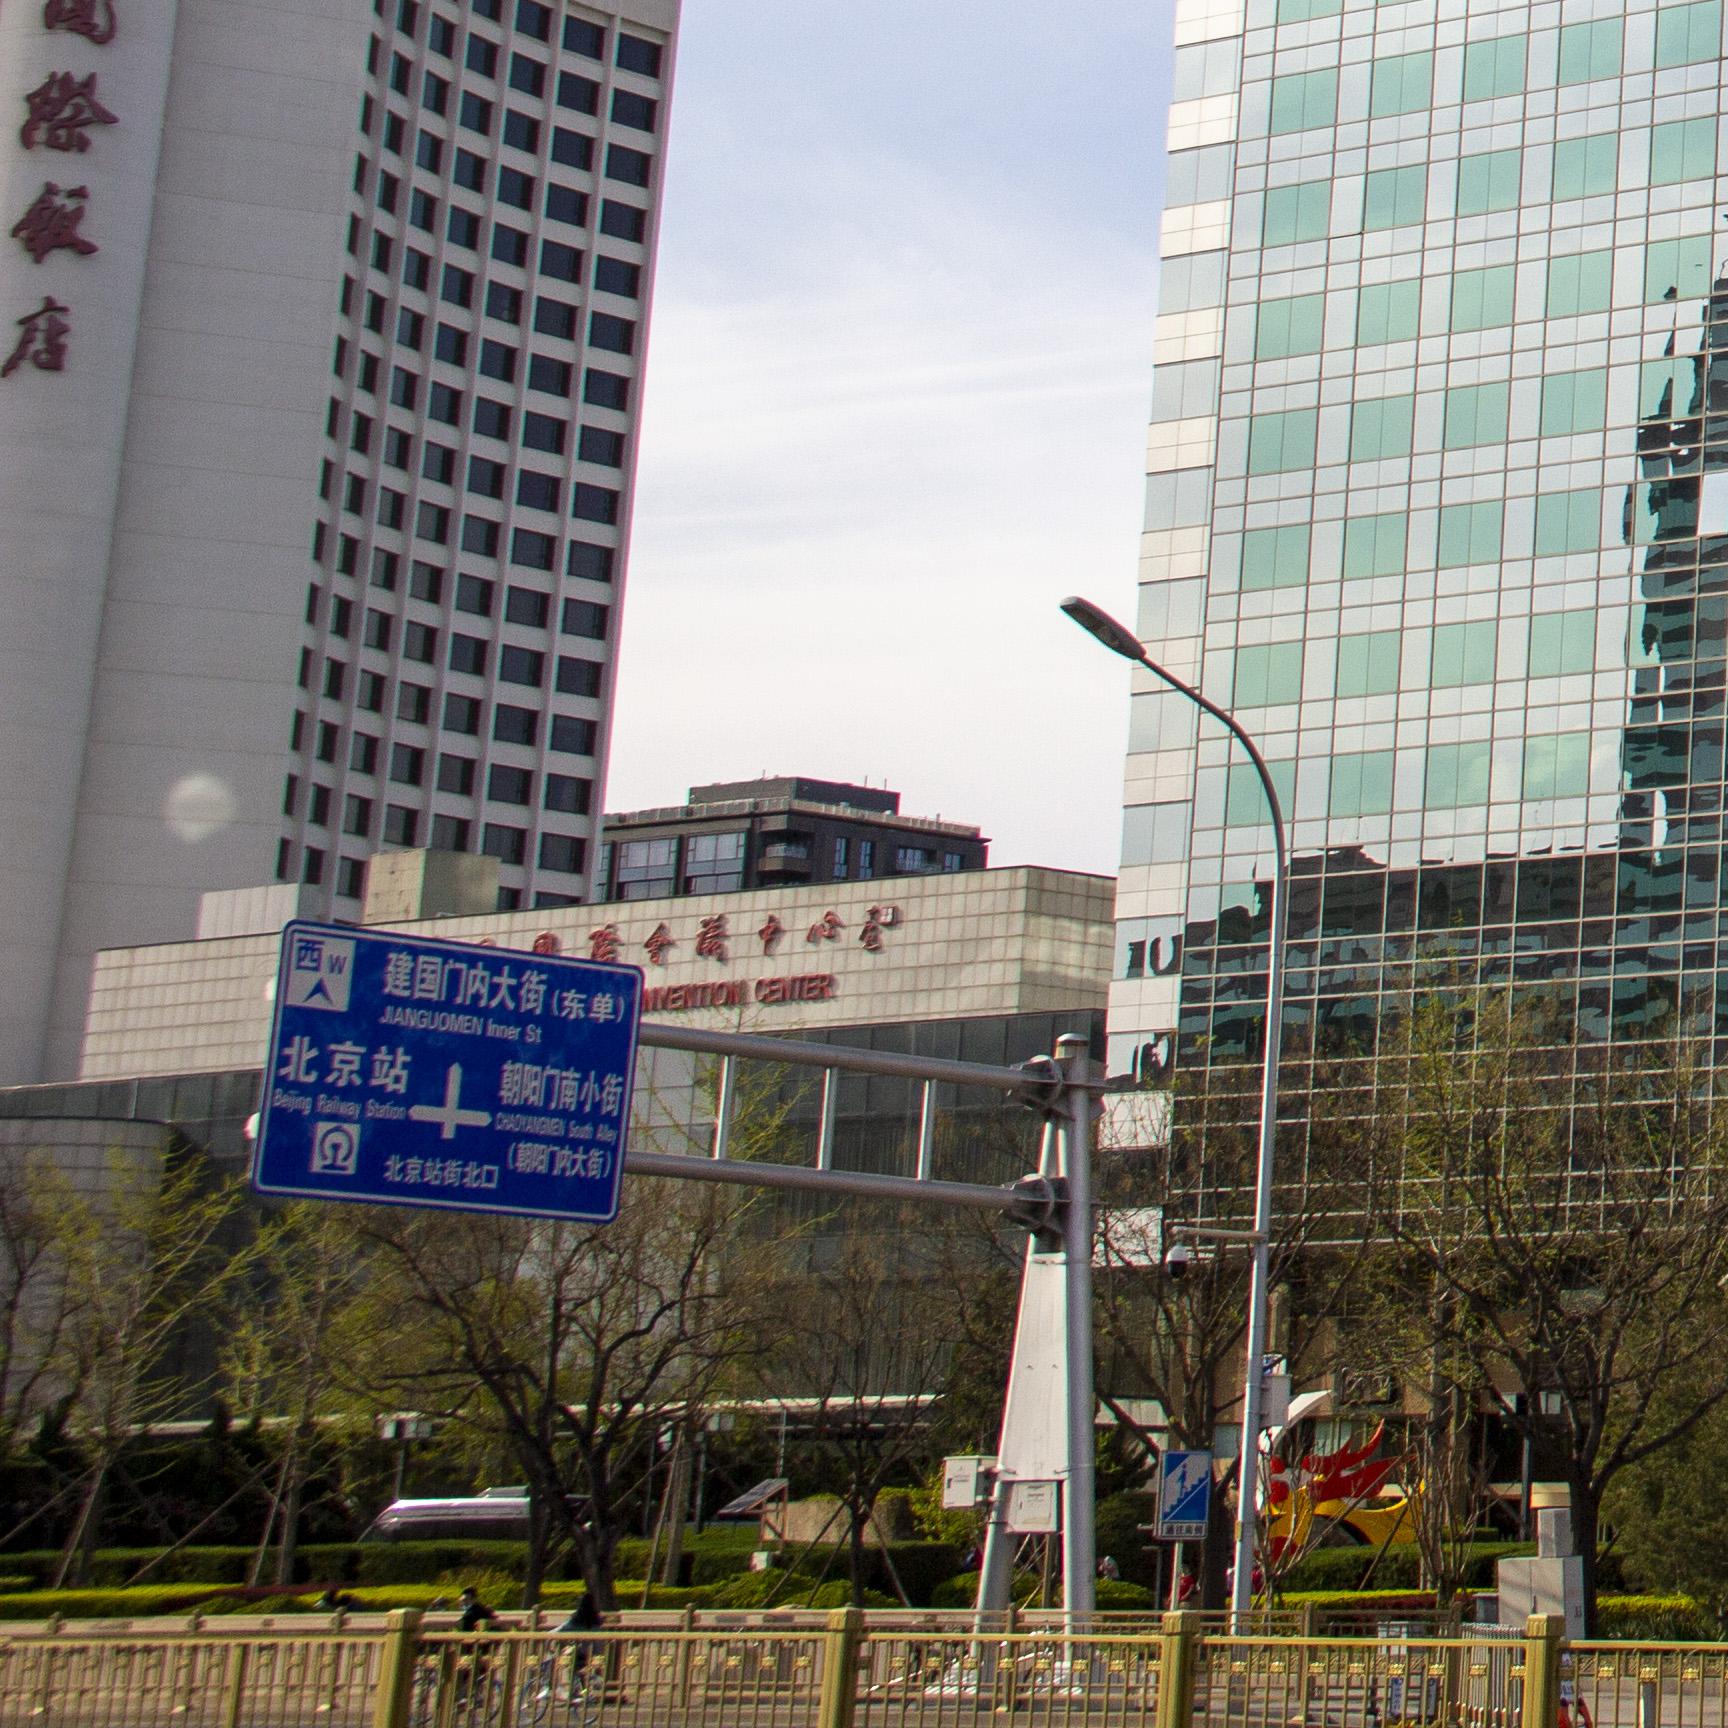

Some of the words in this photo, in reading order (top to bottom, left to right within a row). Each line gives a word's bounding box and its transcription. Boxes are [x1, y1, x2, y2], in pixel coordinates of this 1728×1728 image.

[294, 939, 325, 972] 西
[328, 954, 347, 975] W
[755, 974, 834, 1002] CENTER
[378, 1004, 484, 1037] JIANGUOMEN
[485, 1018, 522, 1042] Inner
[525, 1023, 543, 1045] St
[278, 1035, 412, 1094] 北京站
[272, 1087, 313, 1116] Beijing
[316, 1094, 363, 1119] Railway
[365, 1098, 407, 1120] Station
[499, 1060, 624, 1118] 朝阳门南小街
[383, 1153, 500, 1190] 北京站街北口
